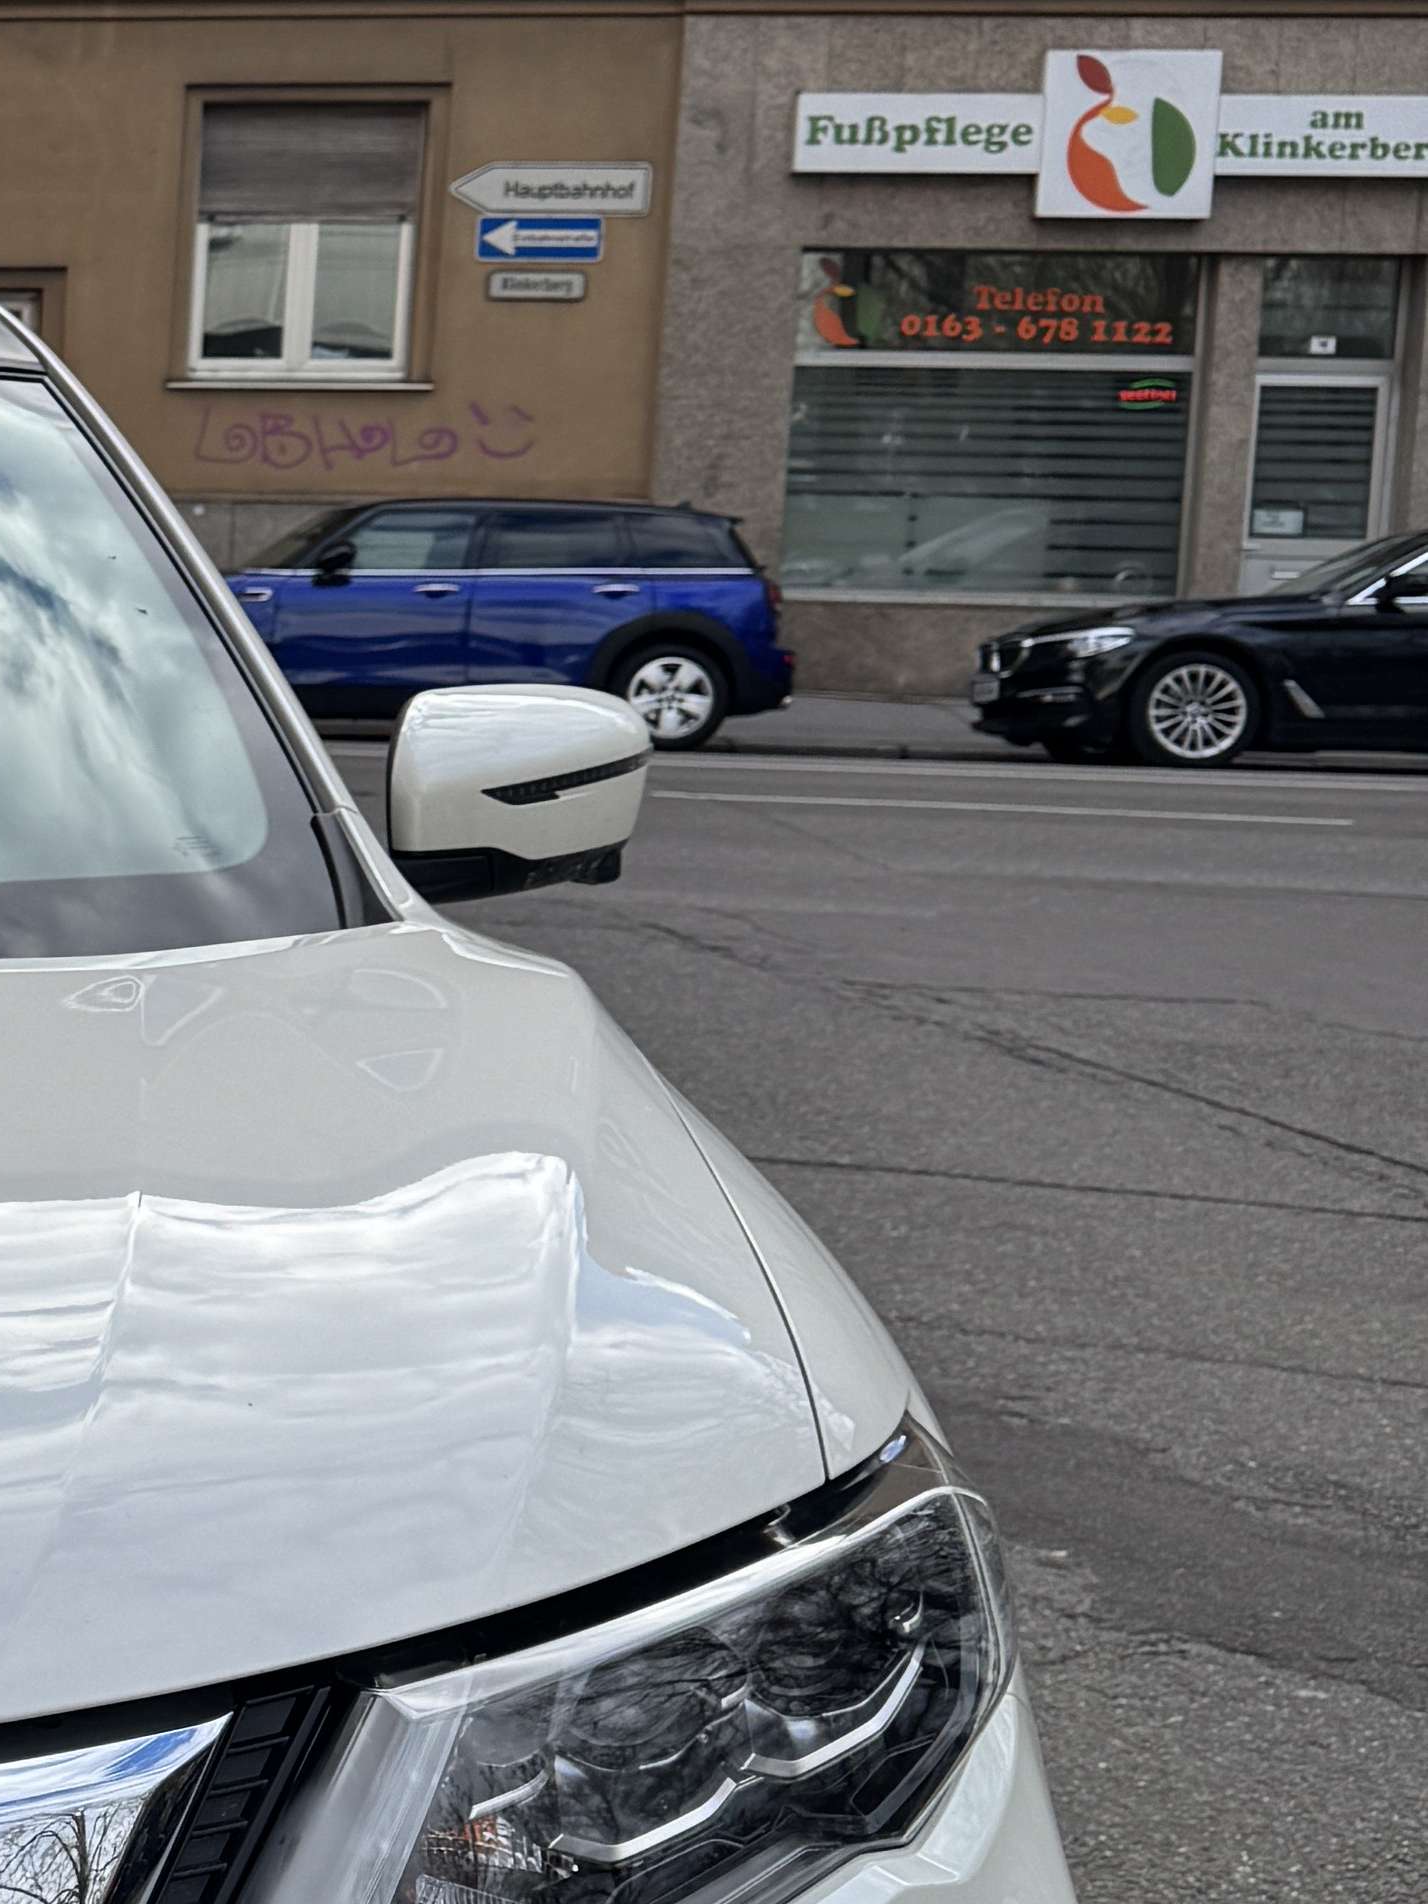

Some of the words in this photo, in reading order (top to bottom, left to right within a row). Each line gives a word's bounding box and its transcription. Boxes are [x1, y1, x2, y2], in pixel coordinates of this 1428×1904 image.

[805, 115, 1034, 154] Fußpflege
[1309, 109, 1365, 130] am
[504, 180, 636, 200] Hauptbahnhof
[974, 283, 1105, 314] Telefon
[900, 313, 983, 342] 0163
[1016, 316, 1079, 345] 678
[1090, 319, 1173, 344] 1122
